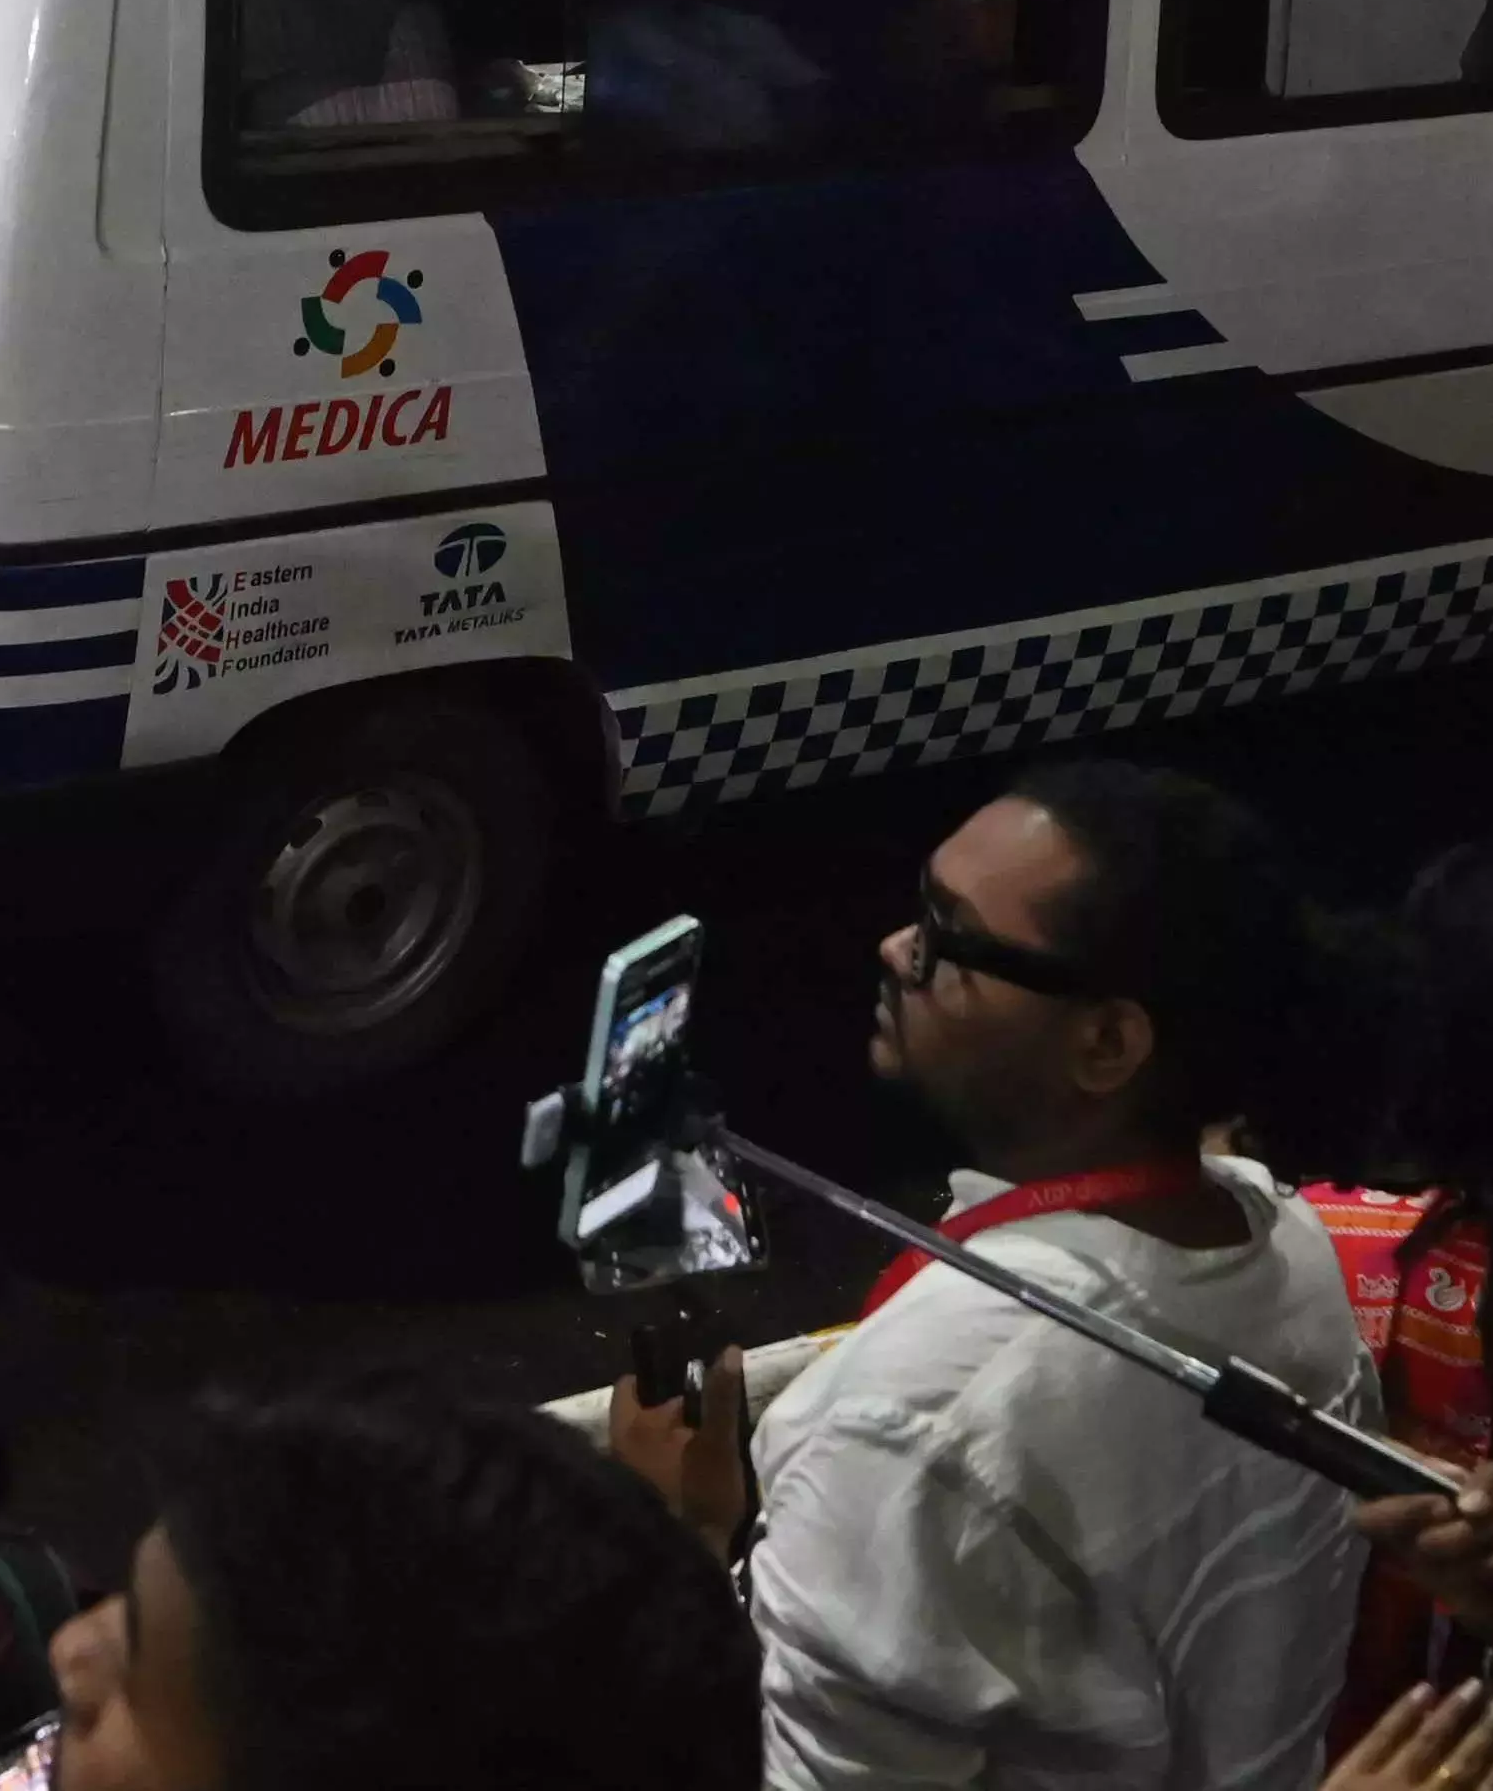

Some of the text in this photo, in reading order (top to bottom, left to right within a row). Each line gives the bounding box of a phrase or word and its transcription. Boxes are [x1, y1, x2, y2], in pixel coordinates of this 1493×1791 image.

[222, 385, 452, 470] MEDICA
[228, 597, 280, 621] India
[419, 580, 507, 618] TATA
[225, 615, 331, 650] Healthcare
[393, 607, 527, 646] TATA METALIKS
[221, 640, 330, 677] Foundation
